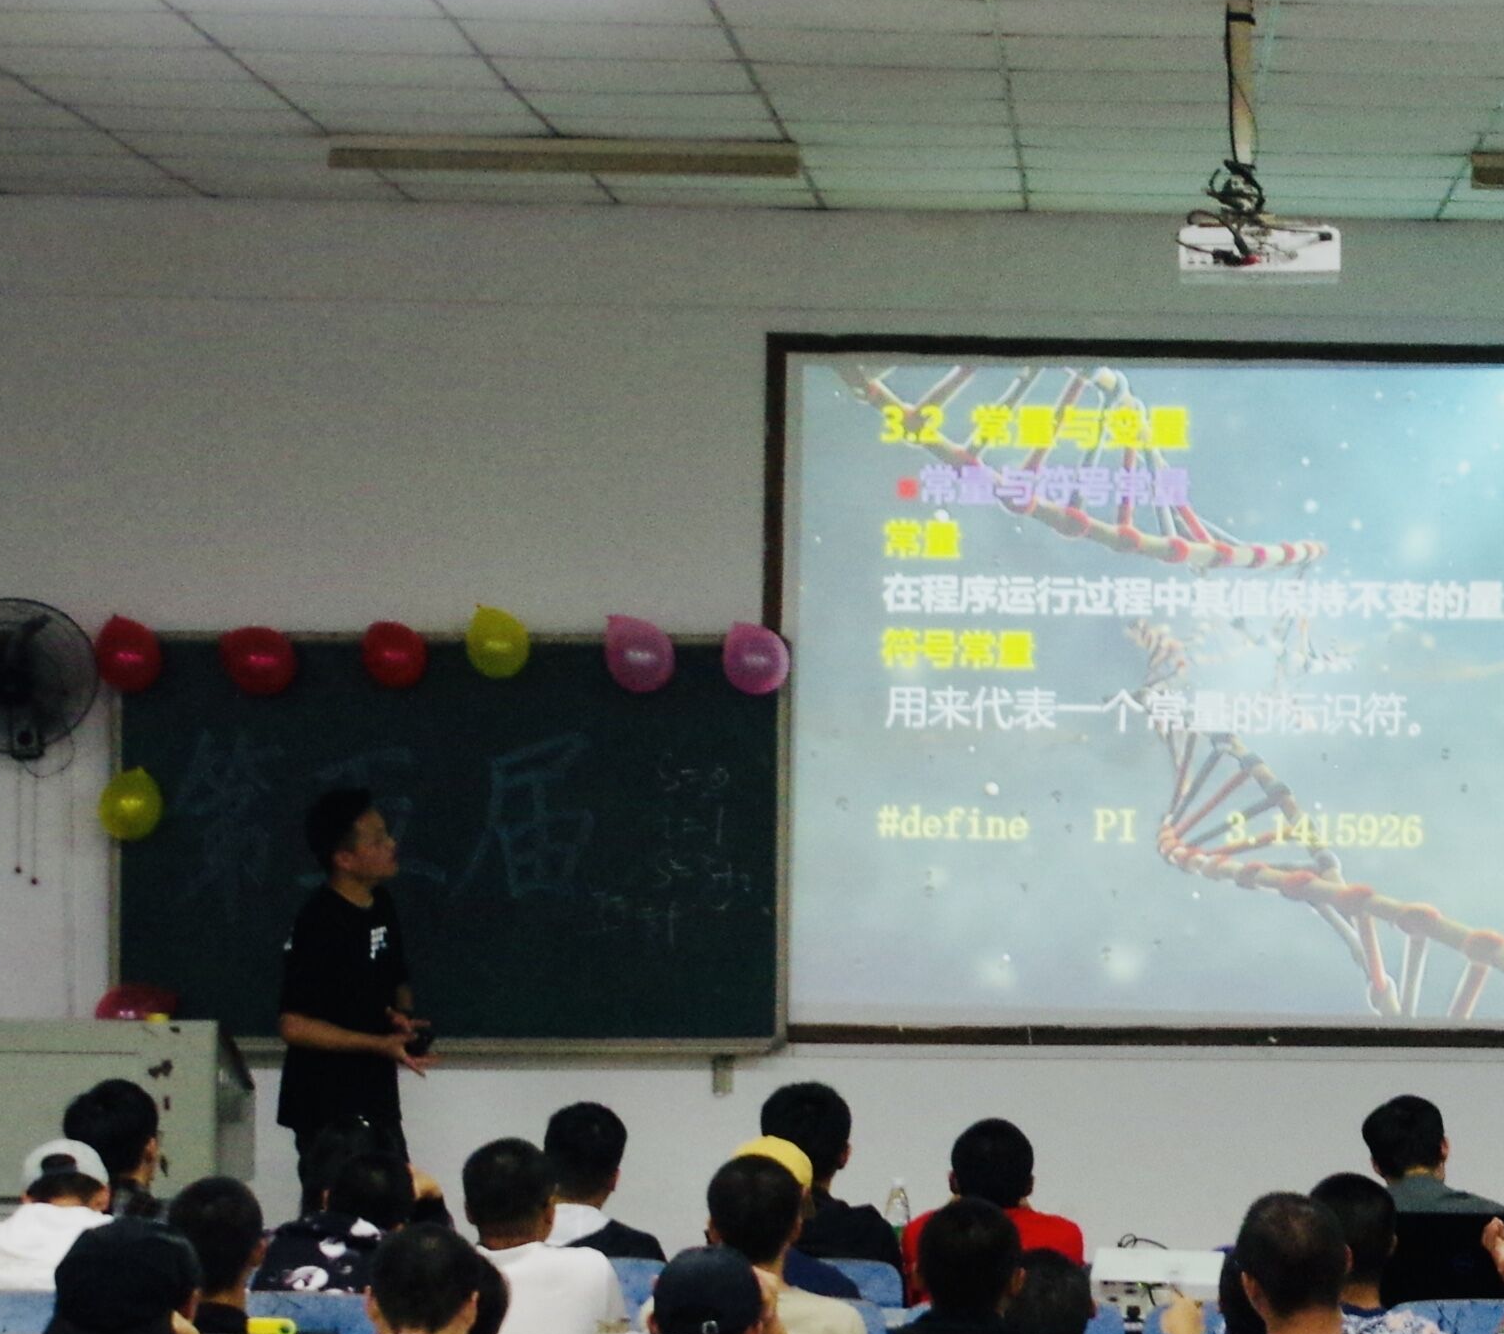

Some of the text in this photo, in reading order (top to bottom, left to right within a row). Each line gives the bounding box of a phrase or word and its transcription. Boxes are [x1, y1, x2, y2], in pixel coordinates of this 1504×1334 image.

[881, 404, 945, 444] 3.2
[920, 464, 1190, 508] 常量与符号常量
[883, 519, 962, 560] 常量
[880, 628, 1036, 671] 符号常量
[884, 684, 1422, 737] 用来代表一个常量的标识符。
[876, 805, 1030, 841] #define
[1093, 808, 1138, 844] PI
